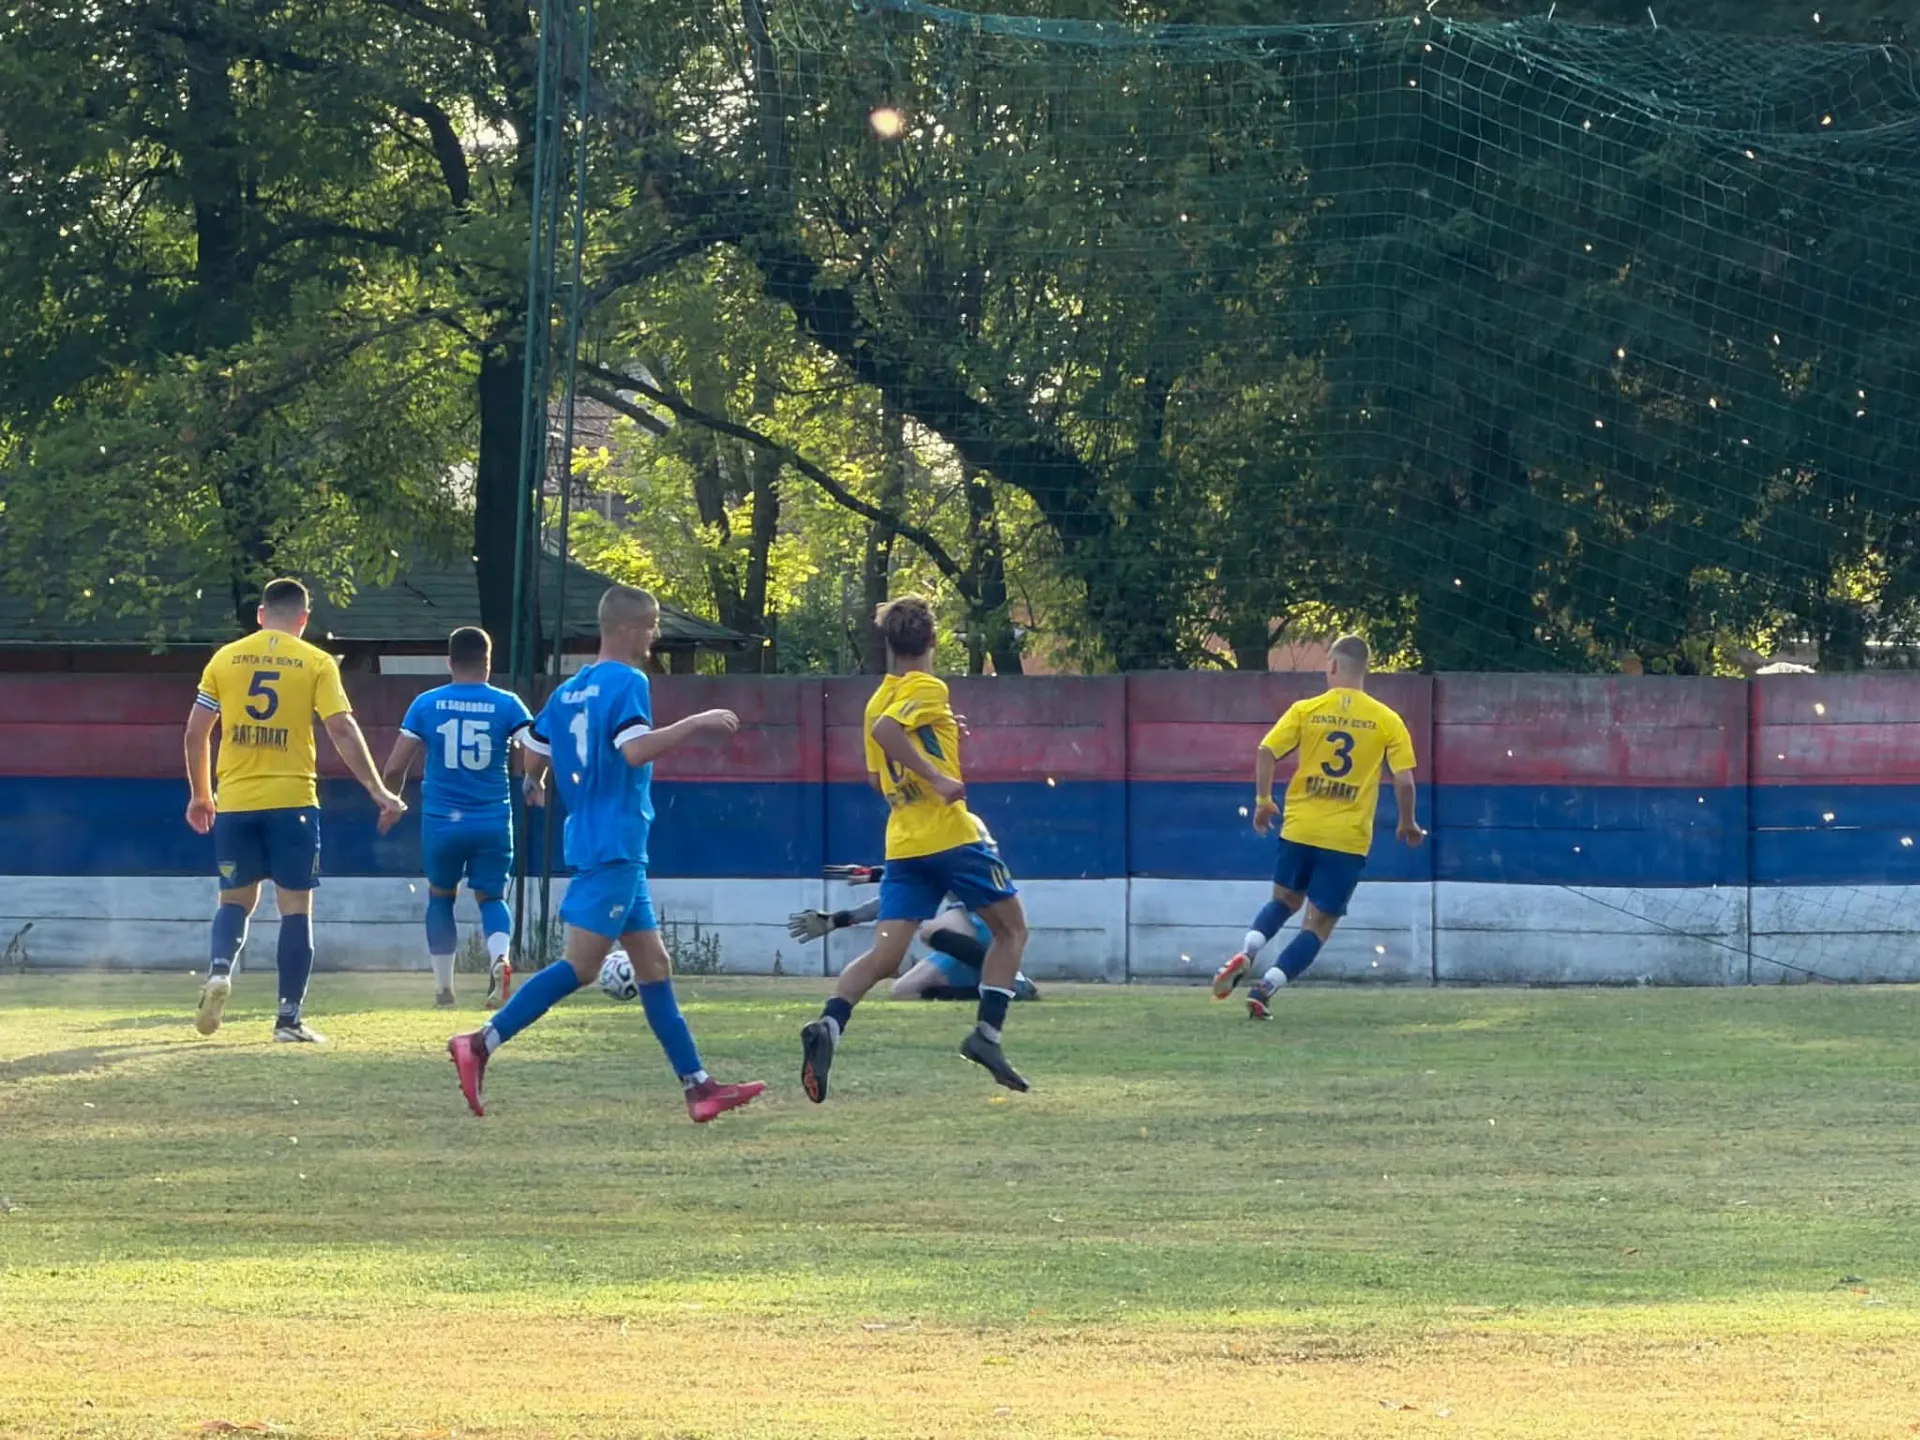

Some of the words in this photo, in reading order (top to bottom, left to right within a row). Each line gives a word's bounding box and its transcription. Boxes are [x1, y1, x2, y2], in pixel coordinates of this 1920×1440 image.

[245, 671, 280, 720] 5
[436, 718, 491, 770] 15
[569, 708, 588, 768] 1
[1321, 730, 1354, 778] 3
